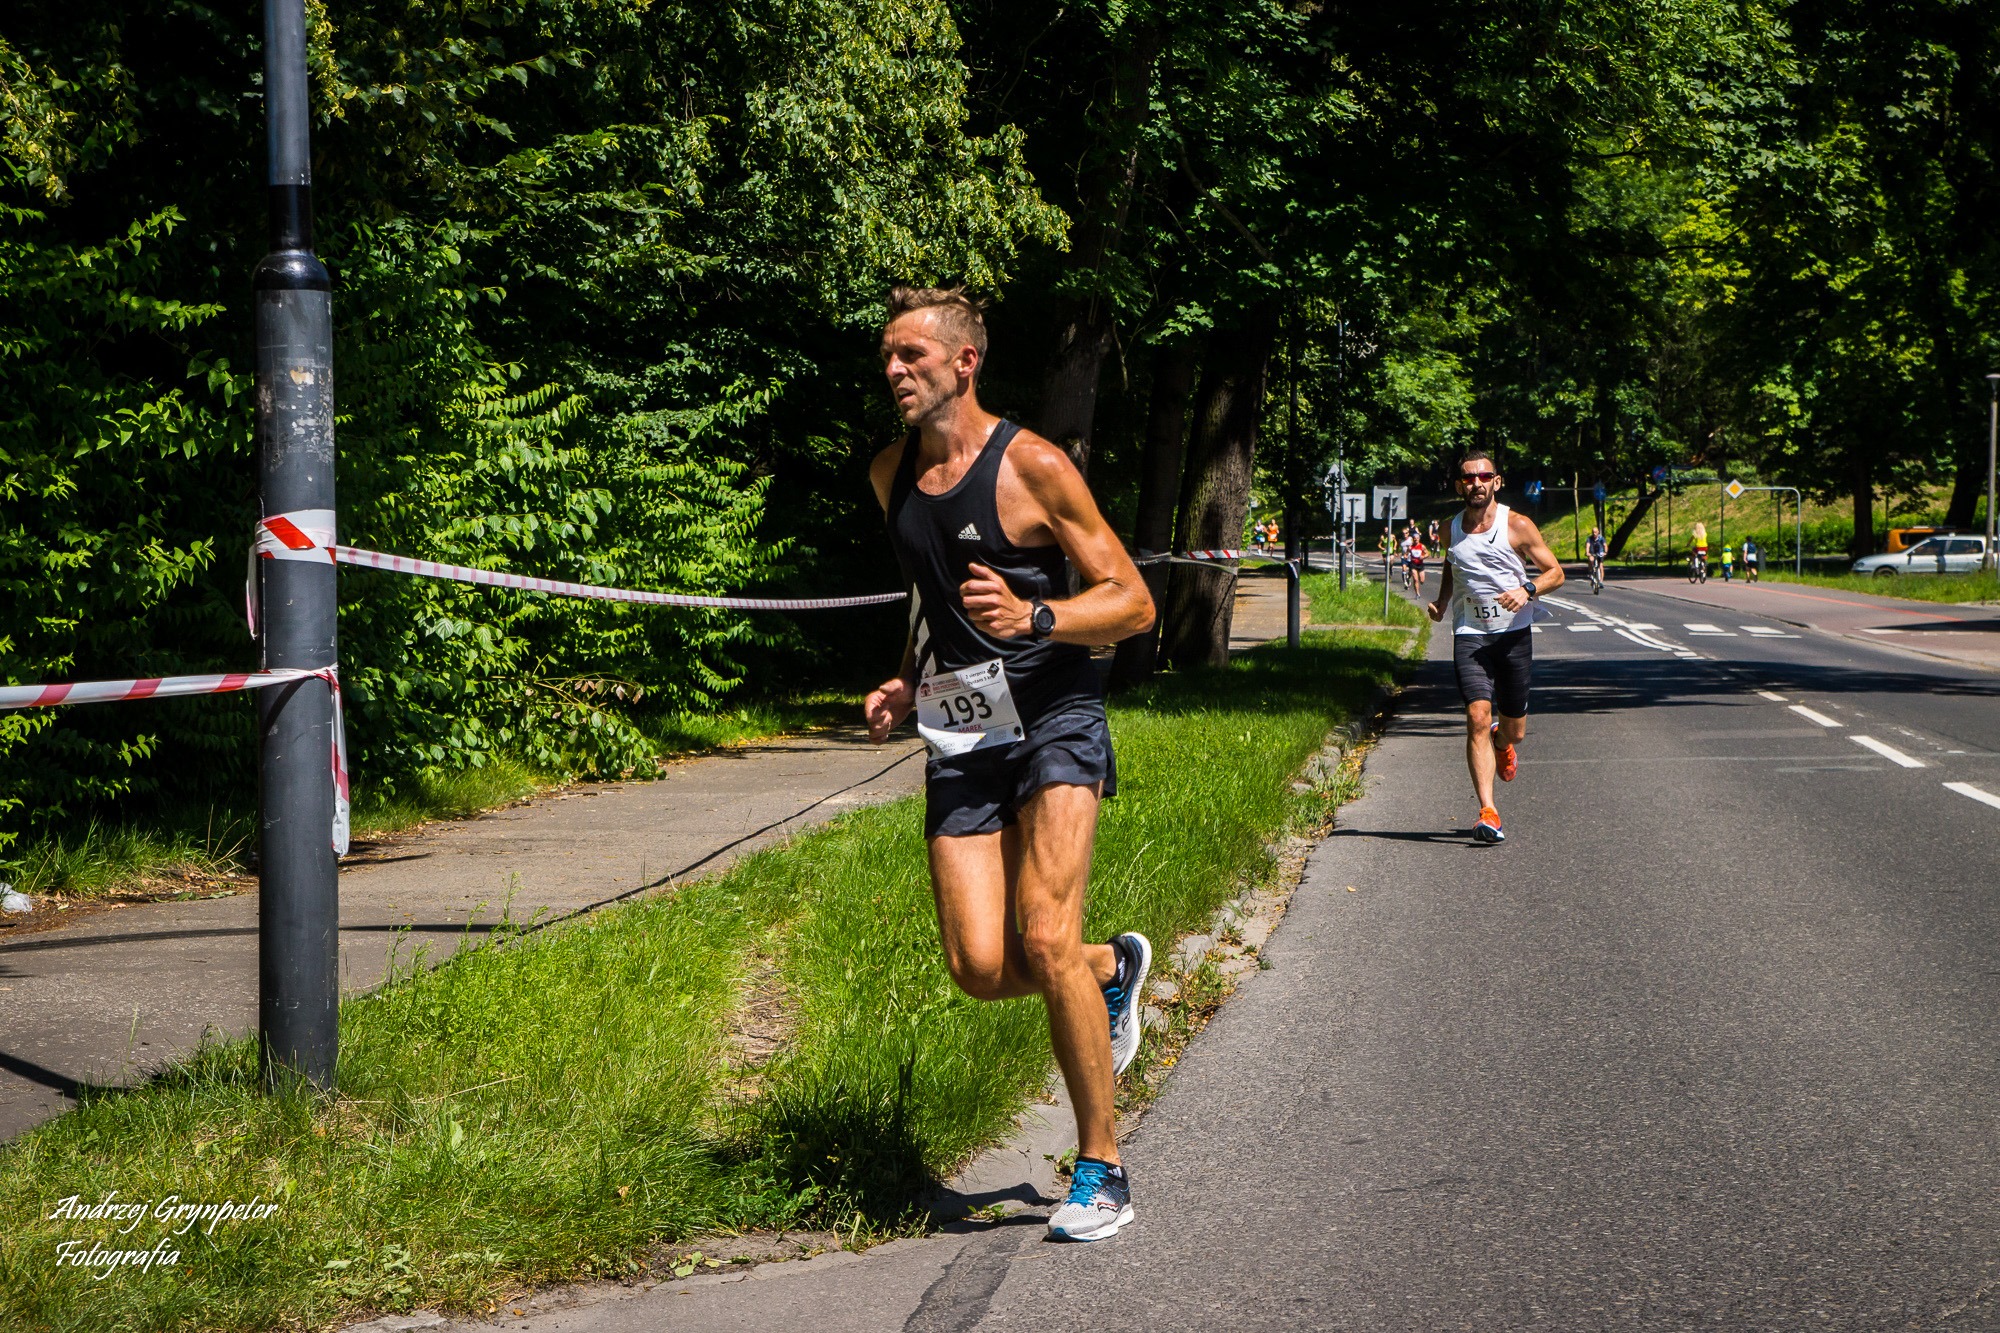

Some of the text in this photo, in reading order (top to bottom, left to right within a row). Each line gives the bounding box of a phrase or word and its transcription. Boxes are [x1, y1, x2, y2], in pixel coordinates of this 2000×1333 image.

[958, 533, 981, 541] adidas
[1474, 605, 1500, 619] 151
[940, 692, 993, 728] 193
[958, 723, 983, 734] MAREK
